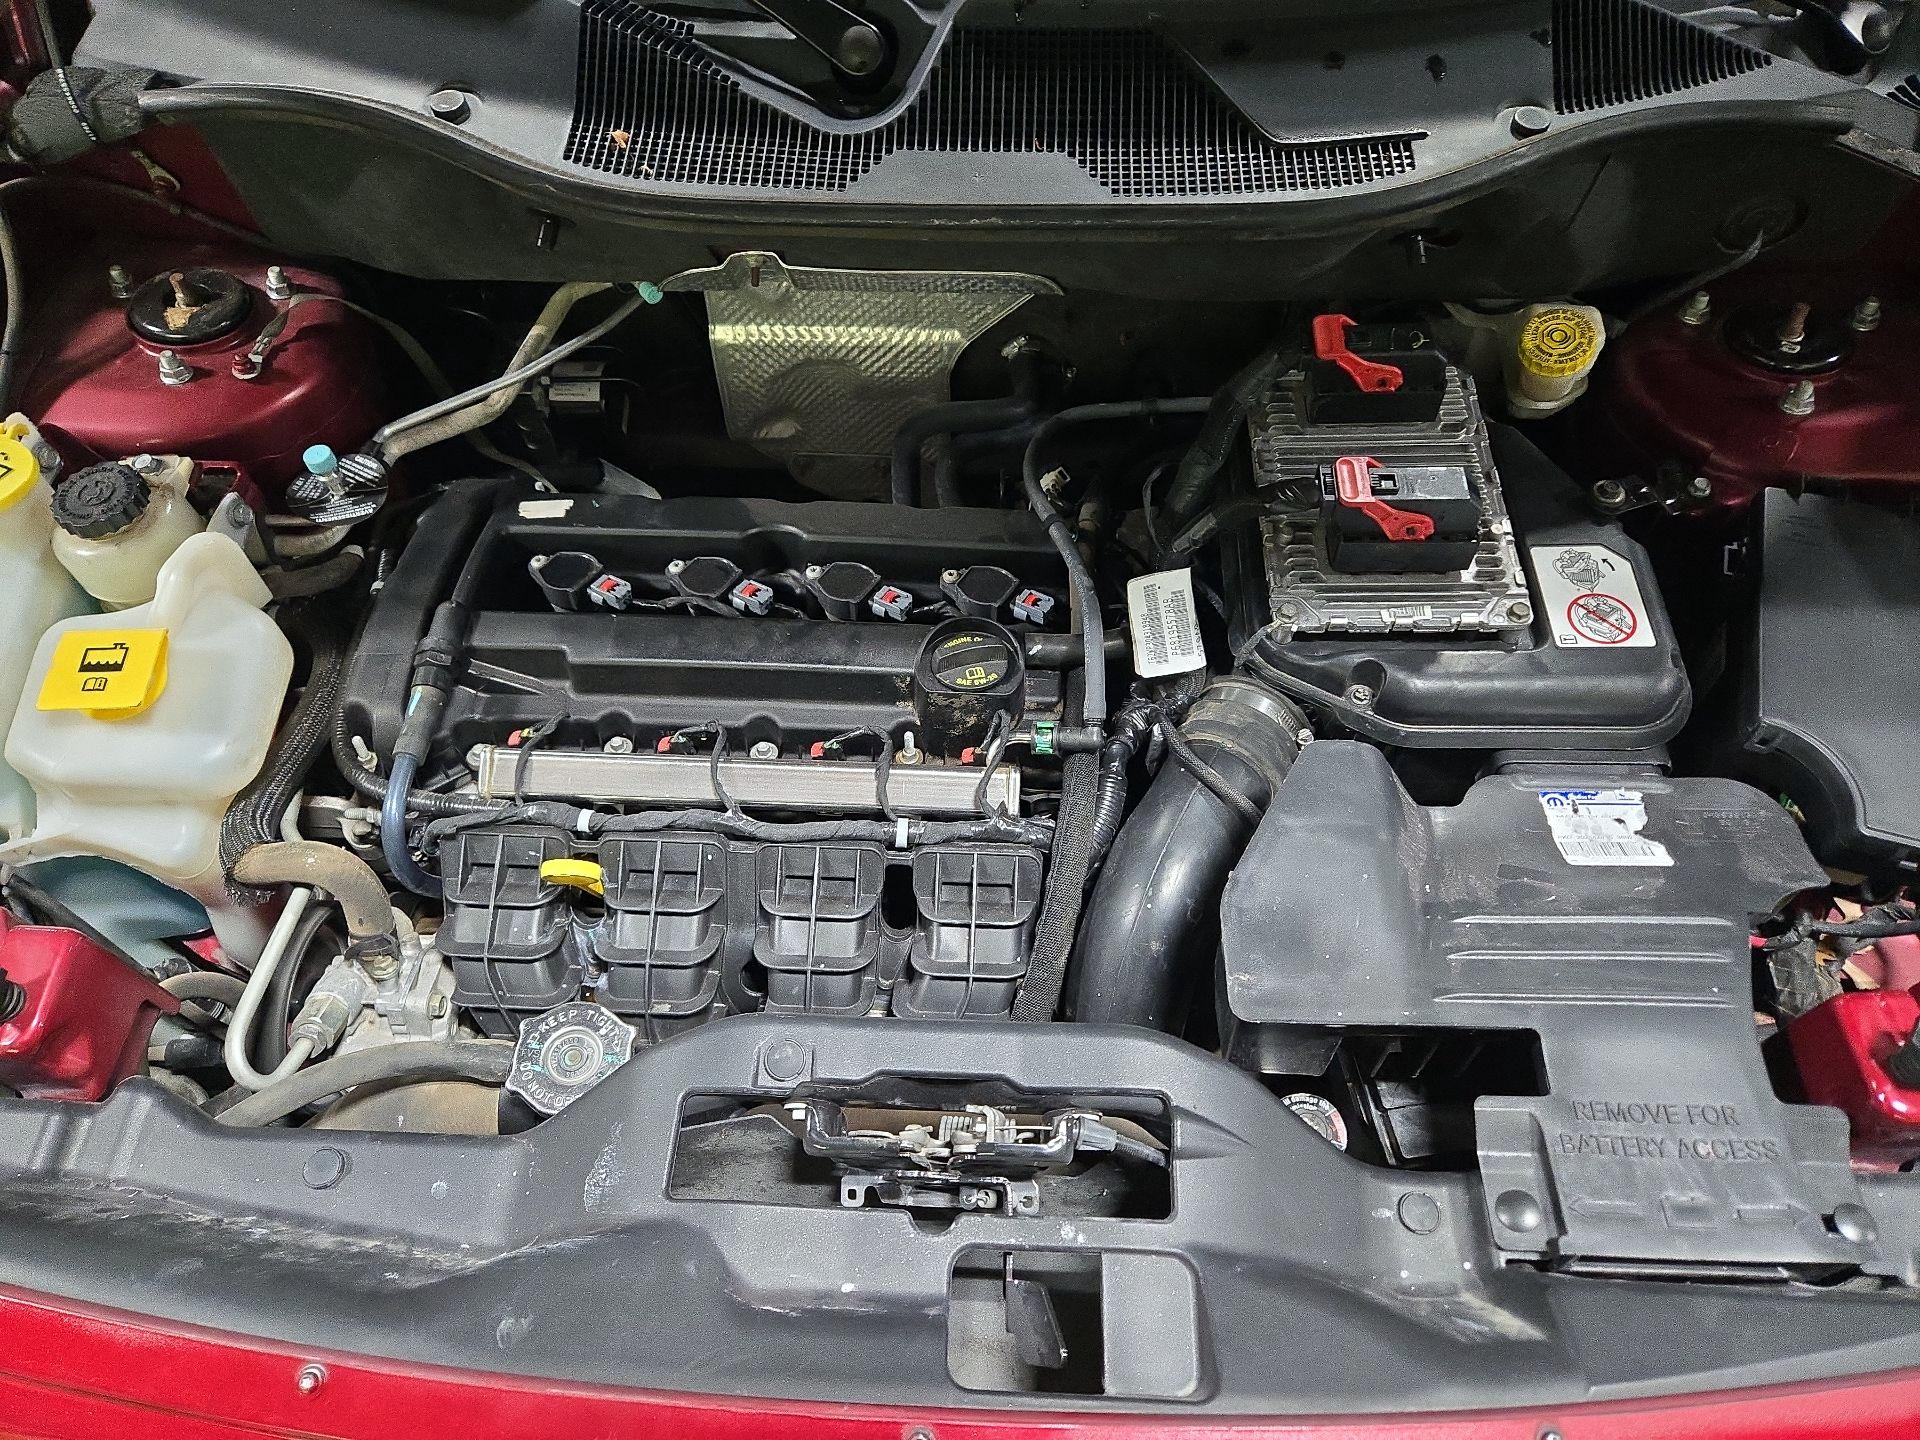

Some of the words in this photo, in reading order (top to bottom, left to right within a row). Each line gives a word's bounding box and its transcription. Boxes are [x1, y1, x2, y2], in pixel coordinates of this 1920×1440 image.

[956, 677, 973, 686] SAE
[540, 1009, 577, 1032] KEEP
[586, 1009, 622, 1040] TIGHT
[527, 1080, 555, 1104] NOT
[1572, 1101, 1680, 1124] REMOVE
[1686, 1104, 1741, 1126] FOR
[1559, 1133, 1665, 1159] BATTERY
[1678, 1137, 1783, 1161] ACCESS
